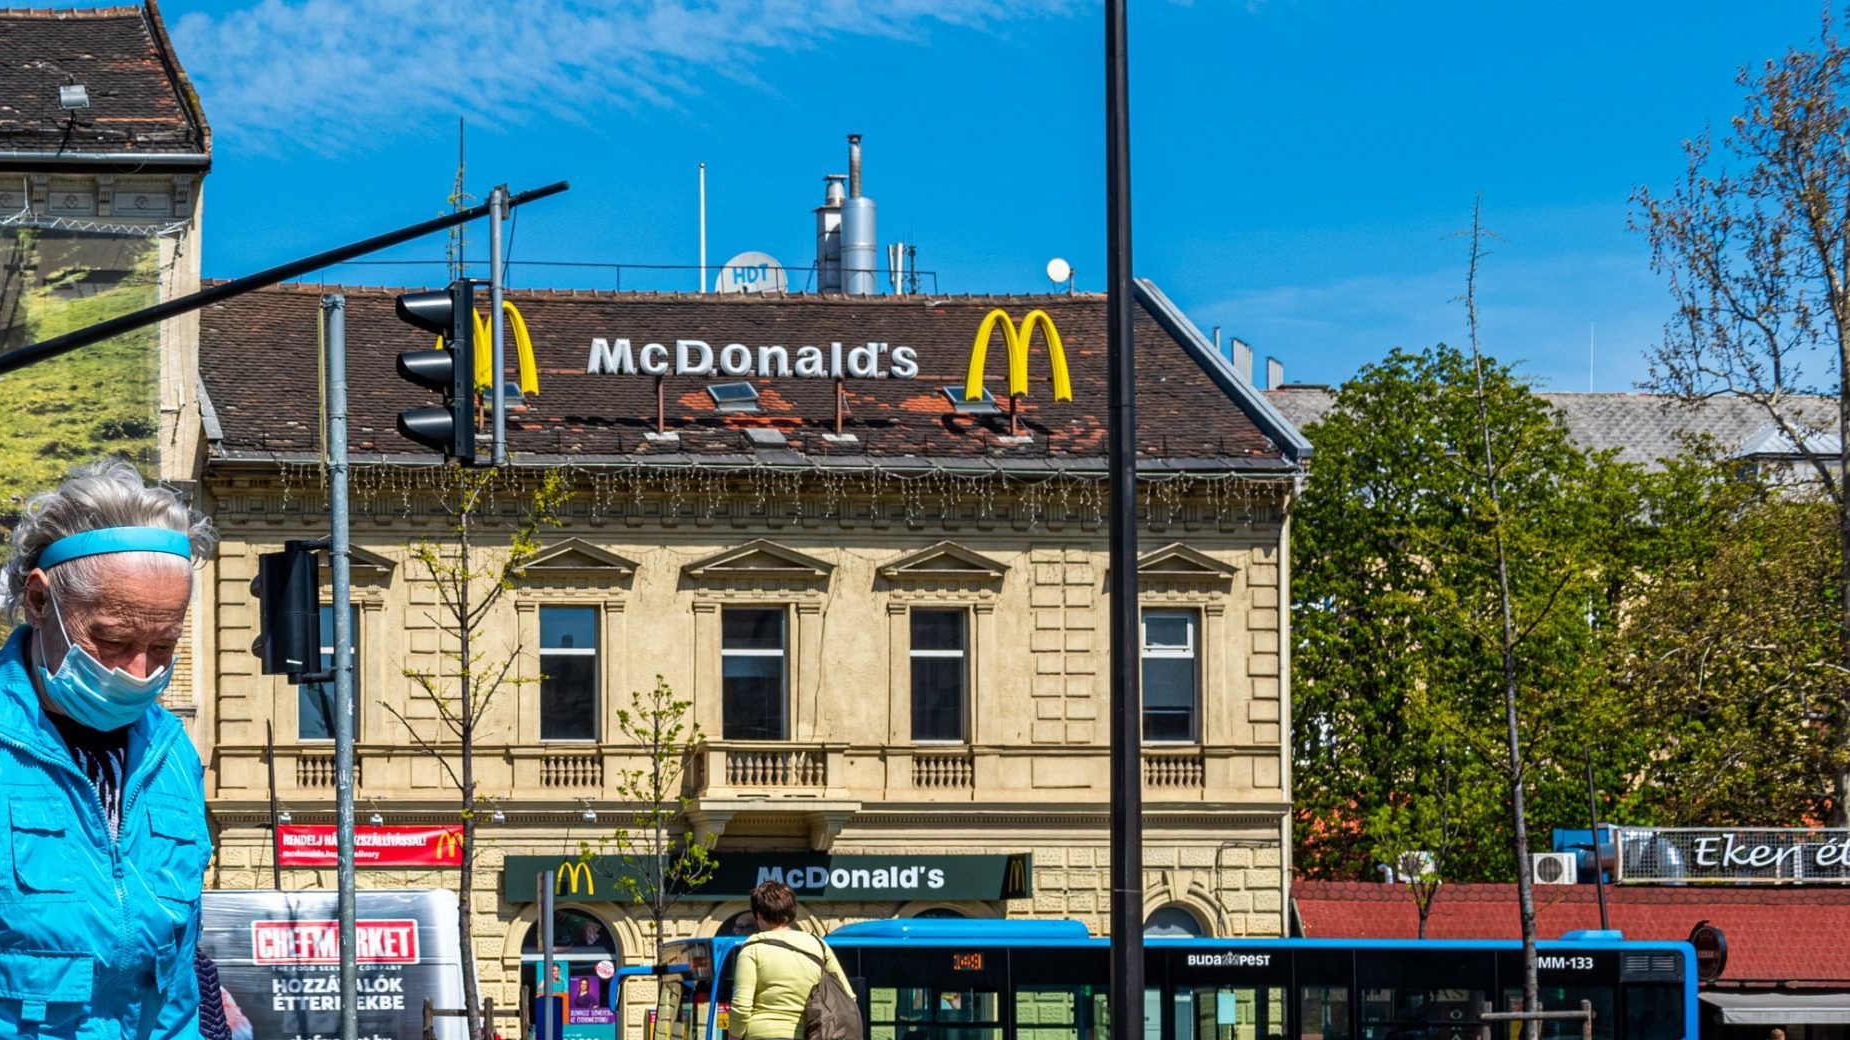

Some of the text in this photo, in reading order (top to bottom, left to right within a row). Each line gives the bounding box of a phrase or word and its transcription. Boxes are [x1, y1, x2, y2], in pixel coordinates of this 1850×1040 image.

[732, 262, 769, 285] HDT
[586, 337, 920, 379] McDonald's
[282, 834, 323, 846] RENDELJ
[756, 866, 946, 889] McDonald's
[257, 926, 411, 959] CHEFMRKET
[1537, 956, 1594, 969] MM-133
[272, 994, 406, 1012] ÉTTEREKBE
